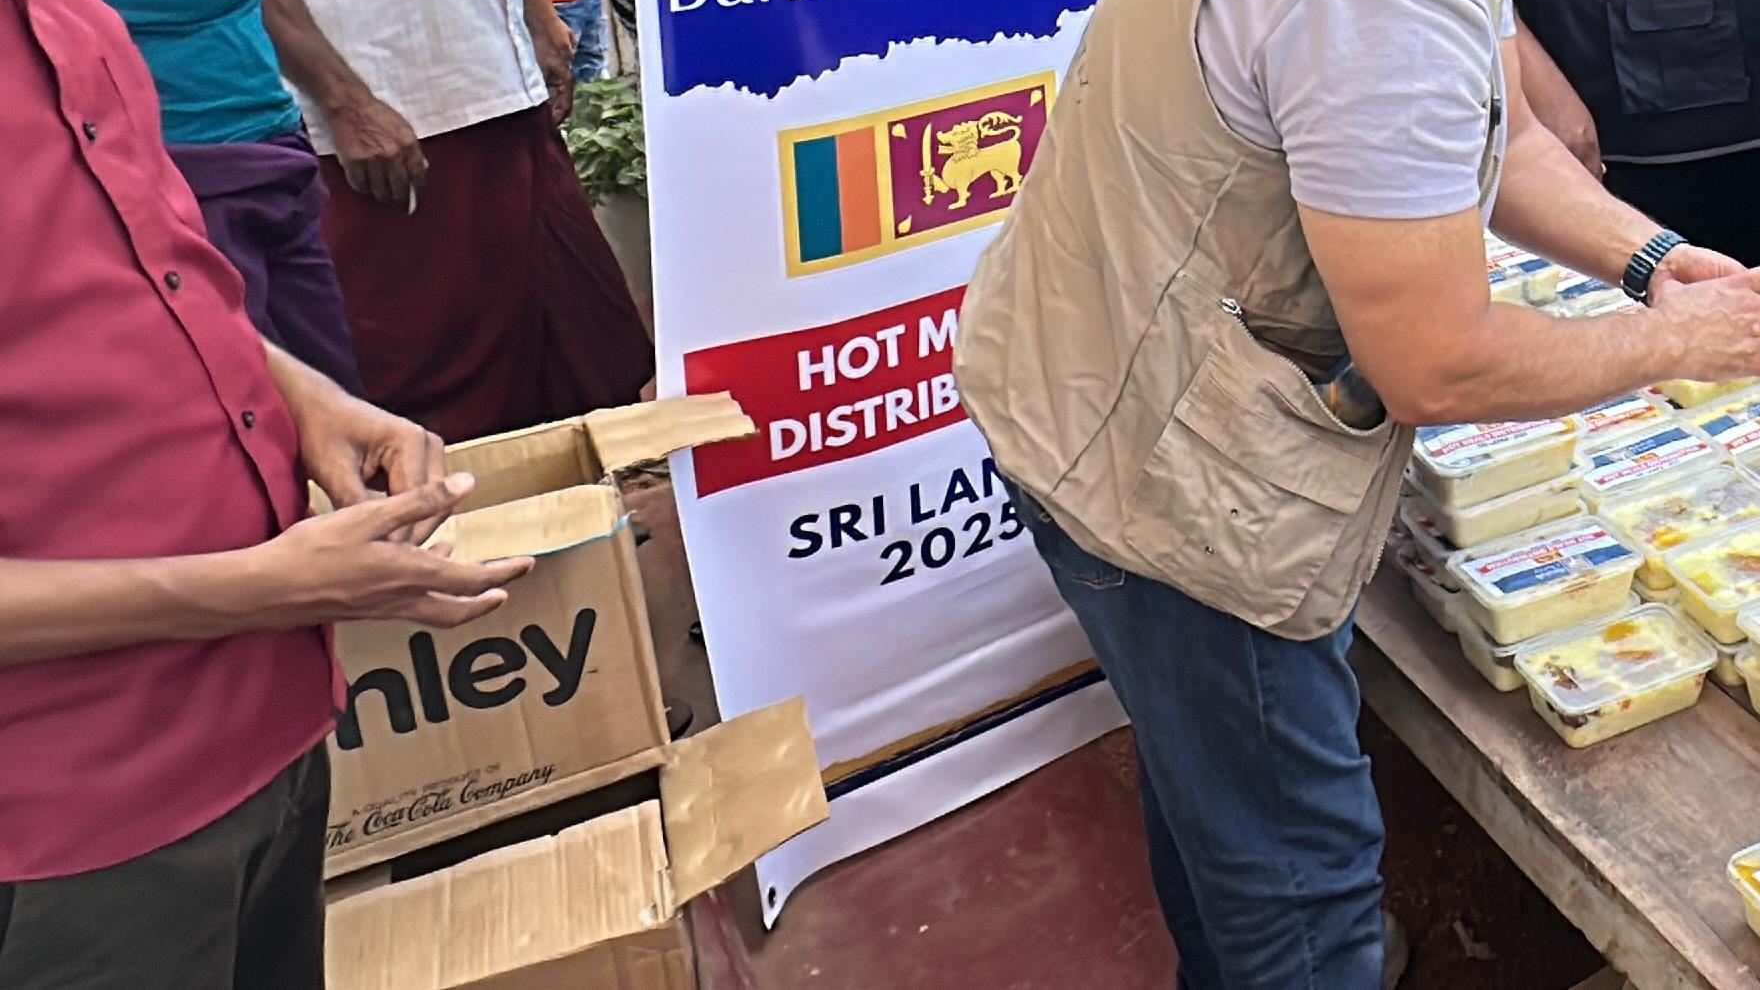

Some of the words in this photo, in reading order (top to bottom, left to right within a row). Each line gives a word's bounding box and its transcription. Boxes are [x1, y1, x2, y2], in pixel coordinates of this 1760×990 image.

[797, 323, 906, 391] HOT
[769, 372, 960, 461] DISTRIB
[787, 495, 886, 559] SRI
[880, 501, 1025, 586] 2025
[335, 607, 598, 752] nley
[460, 764, 557, 804] Company
